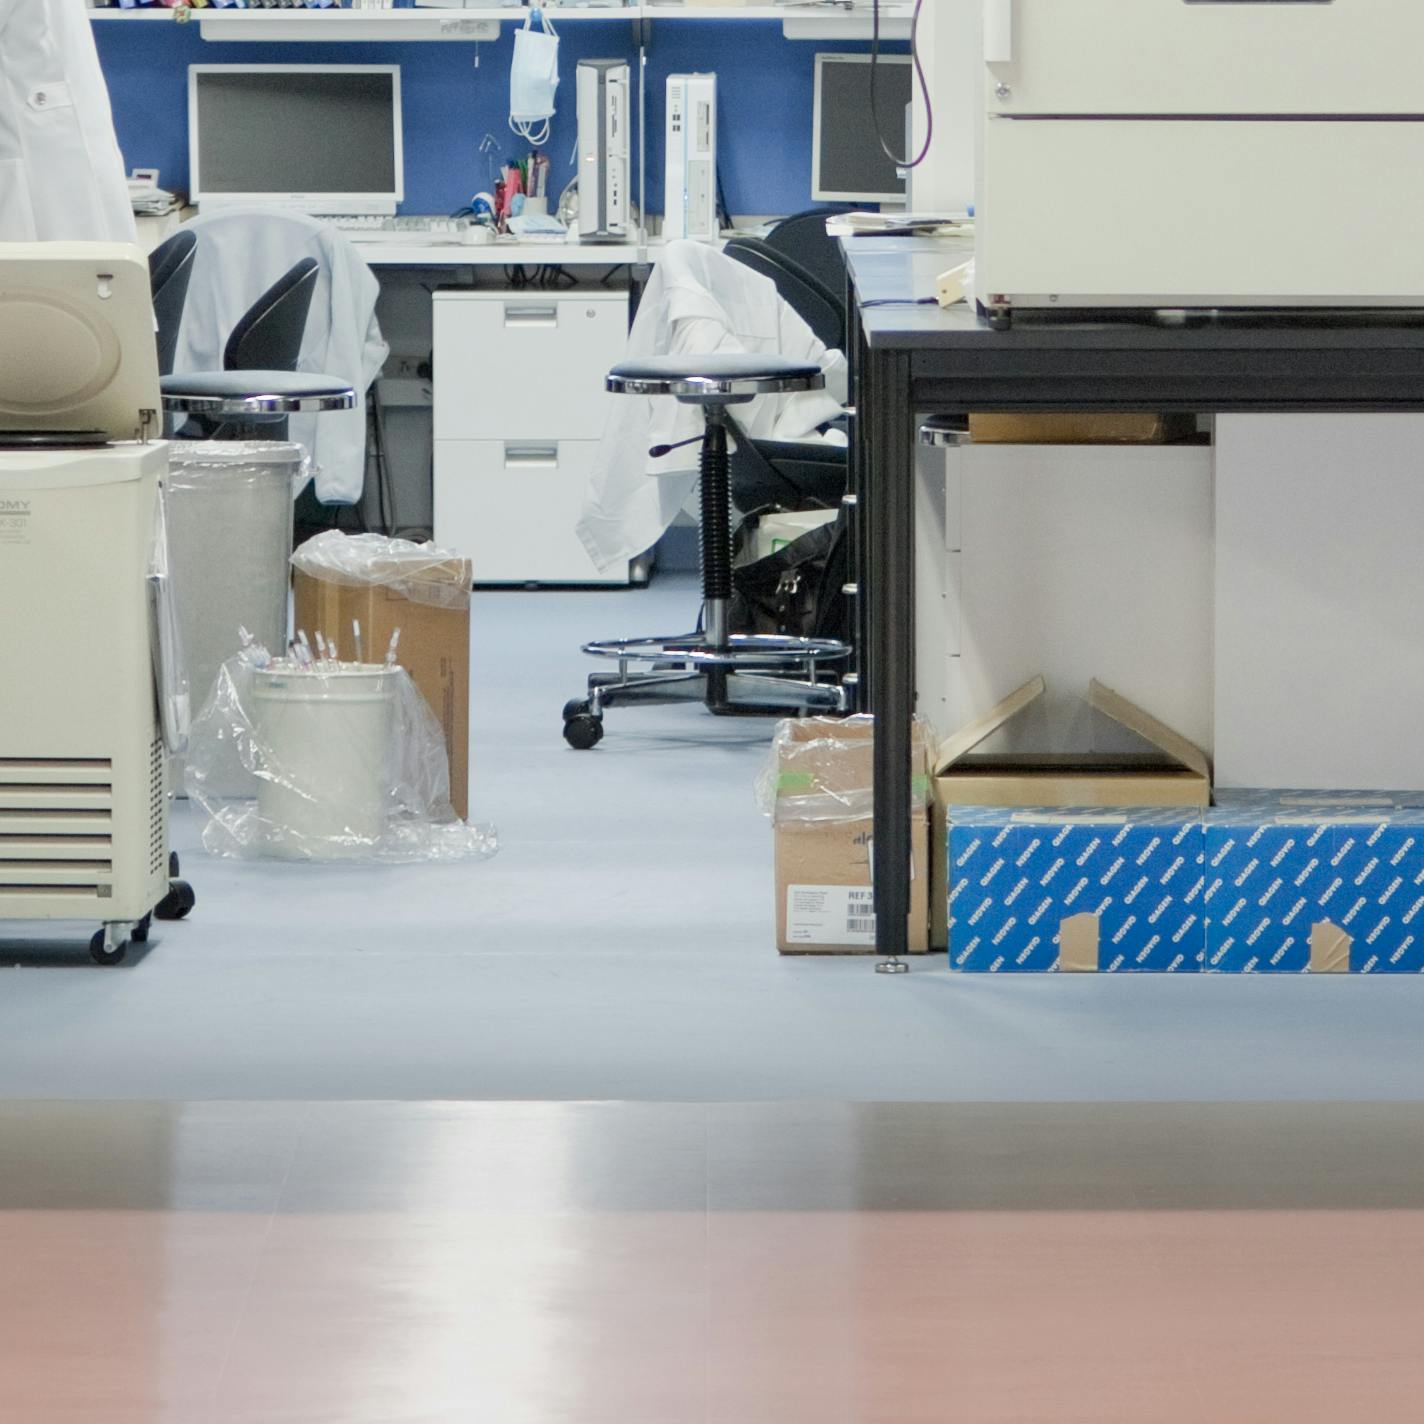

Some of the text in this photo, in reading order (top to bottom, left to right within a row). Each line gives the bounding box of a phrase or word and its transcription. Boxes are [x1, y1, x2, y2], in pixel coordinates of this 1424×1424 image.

[956, 838, 981, 866] QIAGEN
[1016, 839, 1040, 866] QIAGEN
[1076, 838, 1100, 866] QIAGEN
[1136, 837, 1160, 865] QIAGEN
[1211, 839, 1235, 866] QIAGEN
[1271, 839, 1295, 866] QIAGEN
[1331, 838, 1355, 866] QIAGEN
[1390, 838, 1414, 865] QIAGEN
[980, 858, 1004, 886] QIAGEN
[1040, 858, 1064, 885] QIAGEN
[1100, 857, 1124, 885] QIAGEN
[1160, 857, 1184, 884] QIAGEN
[1234, 859, 1259, 886] QIAGEN
[1294, 859, 1318, 886] QIAGEN
[1355, 858, 1378, 885] QIAGEN
[848, 891, 865, 900] REF
[1004, 878, 1028, 905] QIAGEN
[1064, 878, 1088, 905] QIAGEN
[1125, 876, 1148, 904] QIAGEN
[1259, 878, 1282, 906] QIAGEN
[1318, 877, 1342, 905] QIAGEN
[1378, 877, 1402, 904] QIAGEN
[968, 898, 992, 925] QIAGEN
[1028, 897, 1052, 924] QIAGEN
[1149, 896, 1172, 923] QIAGEN
[1223, 898, 1246, 926] QIAGEN
[1282, 897, 1306, 925] QIAGEN
[1343, 897, 1366, 924] QIAGEN
[992, 917, 1016, 944] QIAGEN
[1113, 916, 1136, 943] QIAGEN
[1173, 915, 1196, 942] QIAGEN
[1247, 918, 1270, 944] QIAGEN
[1367, 916, 1390, 943] QIAGEN
[957, 937, 980, 964] QIAGEN
[1017, 937, 1040, 963] QIAGEN
[1137, 935, 1160, 962] QIAGEN
[1211, 938, 1234, 964] QIAGEN
[1271, 937, 1294, 964] QIAGEN
[1390, 936, 1413, 962] QIAGEN
